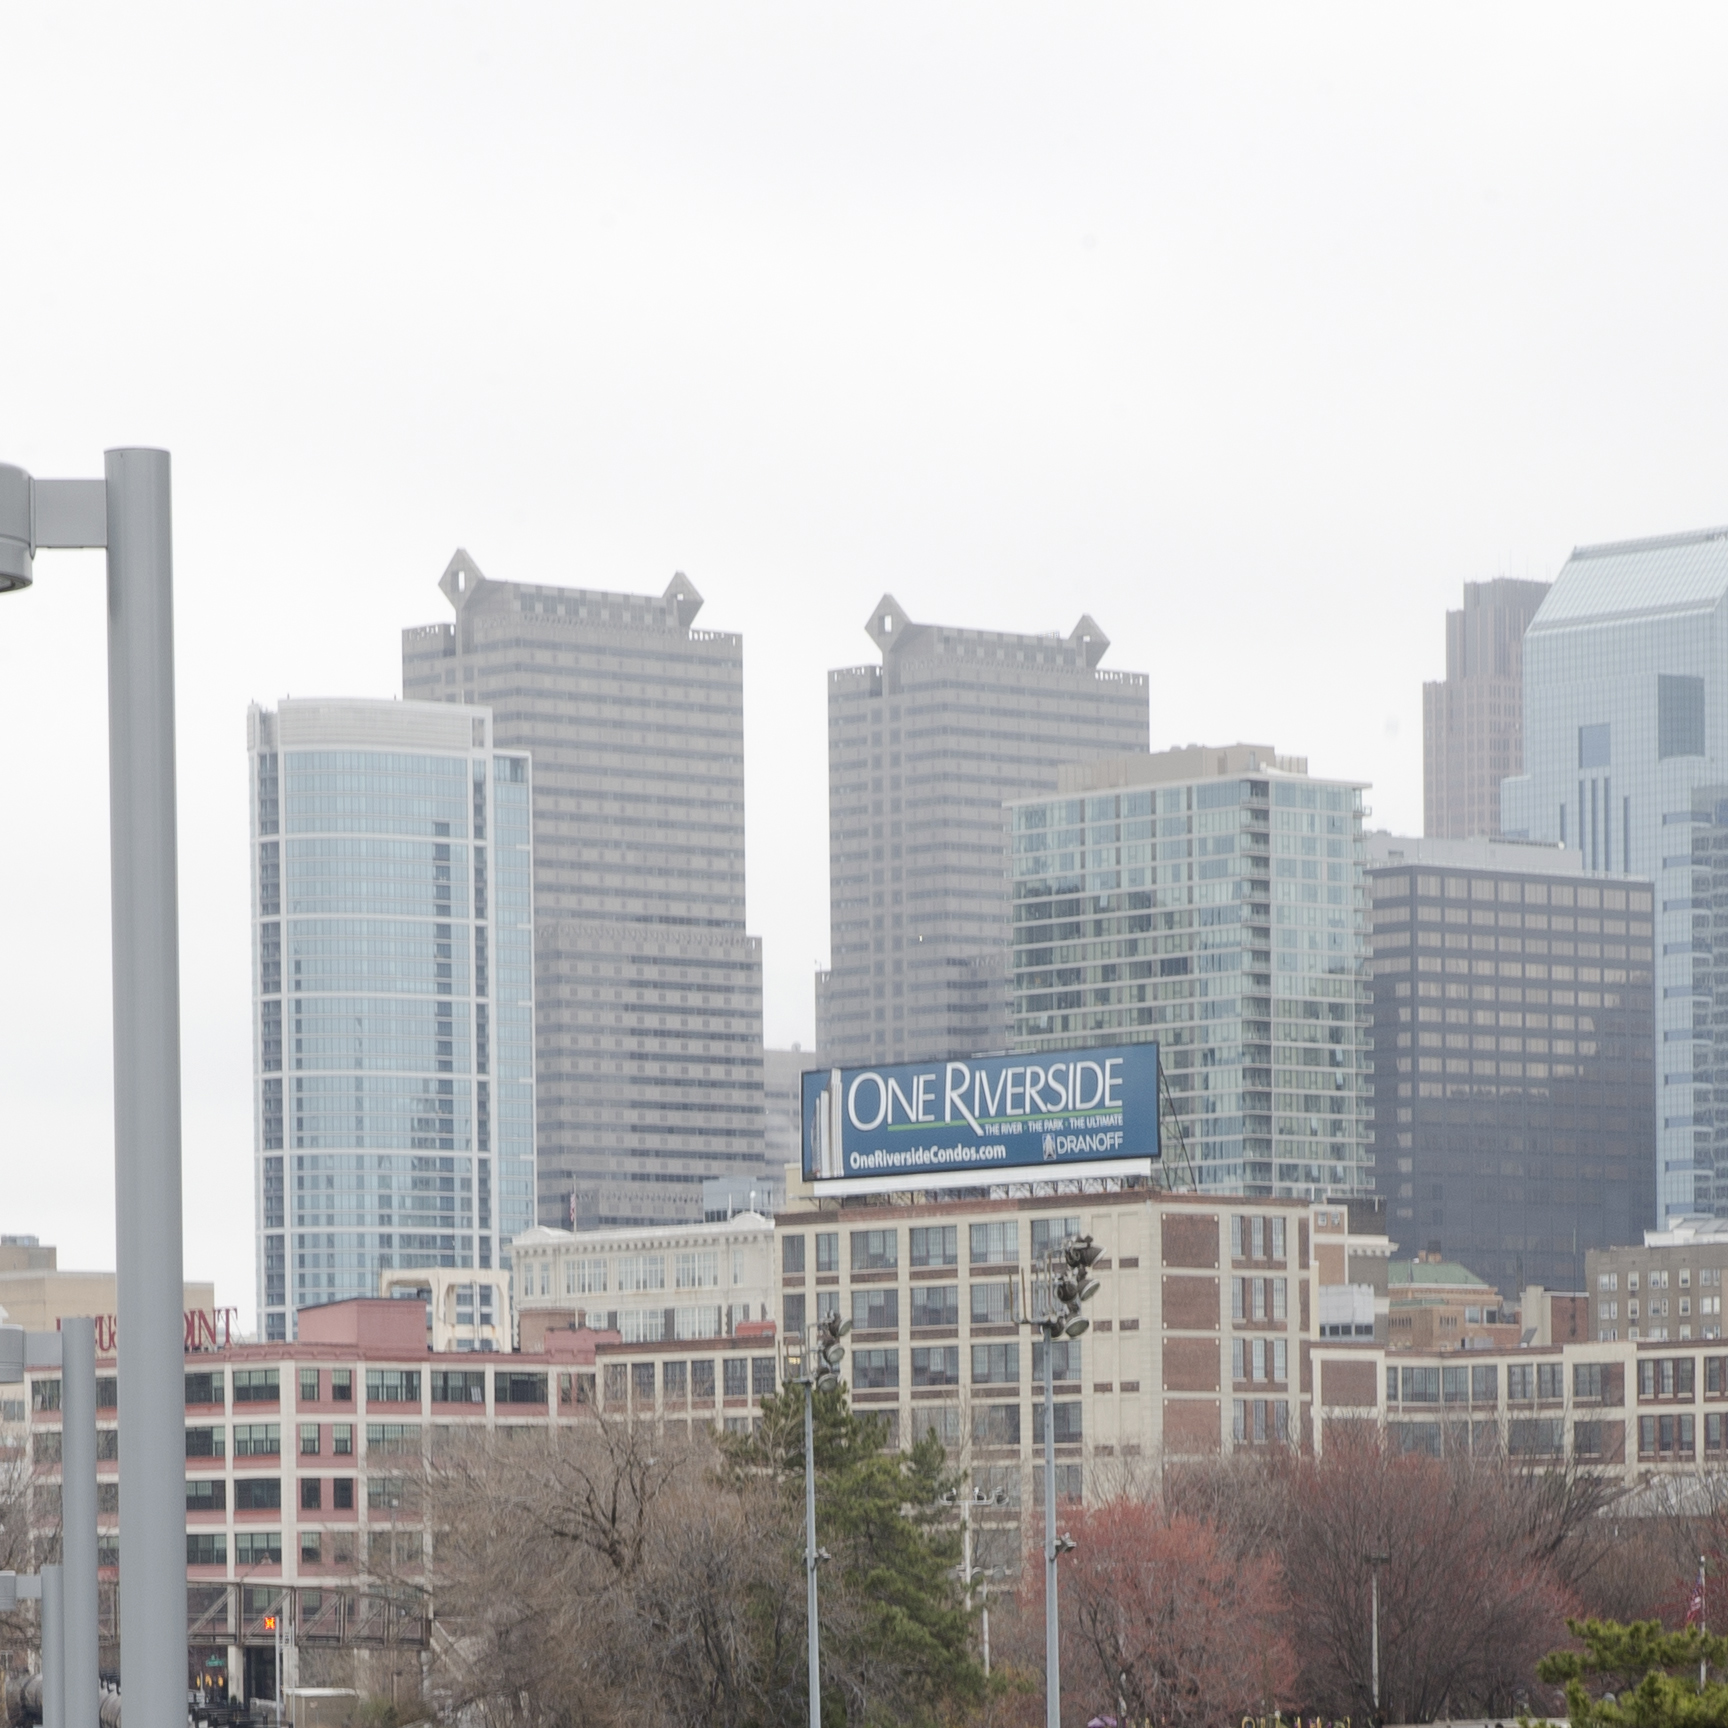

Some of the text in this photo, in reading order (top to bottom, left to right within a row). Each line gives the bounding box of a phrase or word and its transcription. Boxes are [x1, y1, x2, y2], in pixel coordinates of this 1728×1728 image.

[847, 1057, 1124, 1137] ONE RIVERSIDE
[984, 1113, 1123, 1136] THE RIVER THE PARK THE ULTIMATE
[1056, 1131, 1124, 1155] DRANOFF
[849, 1143, 1006, 1170] OneRiversideCondos.com
